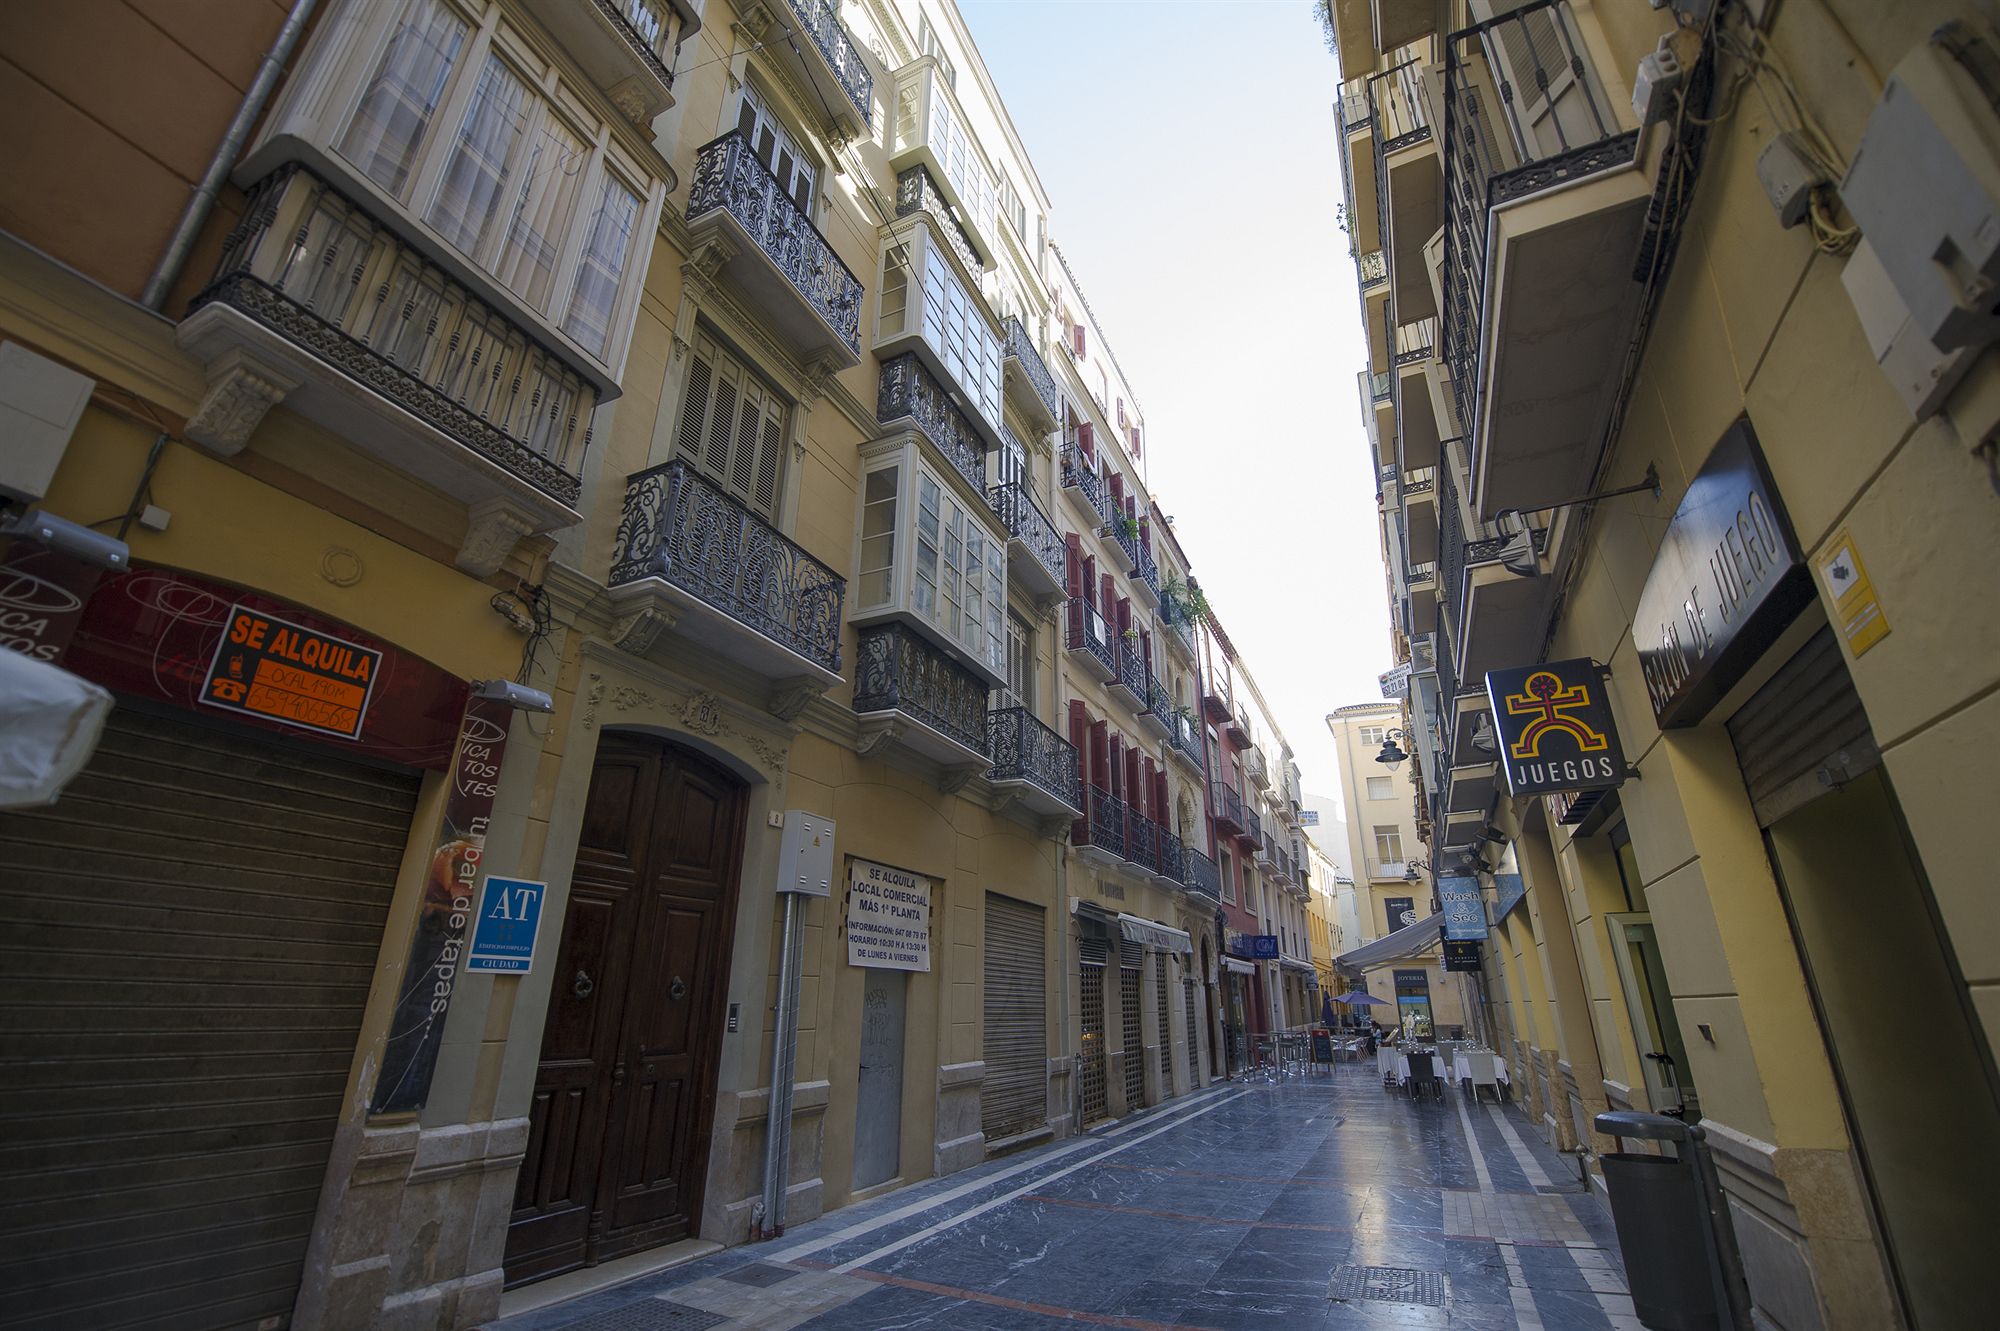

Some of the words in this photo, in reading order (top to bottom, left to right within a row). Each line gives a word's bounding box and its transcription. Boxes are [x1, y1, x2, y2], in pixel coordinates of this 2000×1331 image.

[1645, 620, 1690, 715] SALÓN
[1683, 585, 1713, 660] DE
[1710, 490, 1780, 625] JUEGO
[230, 615, 270, 650] SE
[268, 628, 371, 682] ALQUILA
[257, 663, 308, 691] LOCAL
[1388, 664, 1410, 676] ALQUILA
[464, 760, 499, 778] TOS
[1517, 757, 1613, 785] JUEGOS
[464, 779, 497, 797] TES
[469, 816, 491, 837] tu
[458, 847, 485, 889] bar
[869, 868, 881, 881] SE
[882, 872, 916, 889] ALQUILA
[488, 886, 537, 921] AT
[852, 881, 881, 897] LOCAL
[883, 888, 928, 907] COMERCIAL
[1442, 891, 1479, 901] Wash
[449, 897, 472, 929] de
[859, 898, 879, 912] MÁS
[891, 906, 921, 921] PLANTA
[1452, 913, 1478, 923] Sec
[1457, 902, 1468, 914] &
[848, 920, 894, 935] INFORMACIÓN:
[849, 934, 878, 946] HORARIO
[879, 938, 895, 948] 10:30
[895, 940, 900, 949] H
[900, 941, 905, 949] A
[906, 942, 920, 951] 13:30
[482, 959, 519, 969] CIUDAD
[857, 949, 866, 958] DE
[867, 950, 887, 960] LUNES
[888, 952, 893, 961] A
[894, 953, 919, 963] VIERNES
